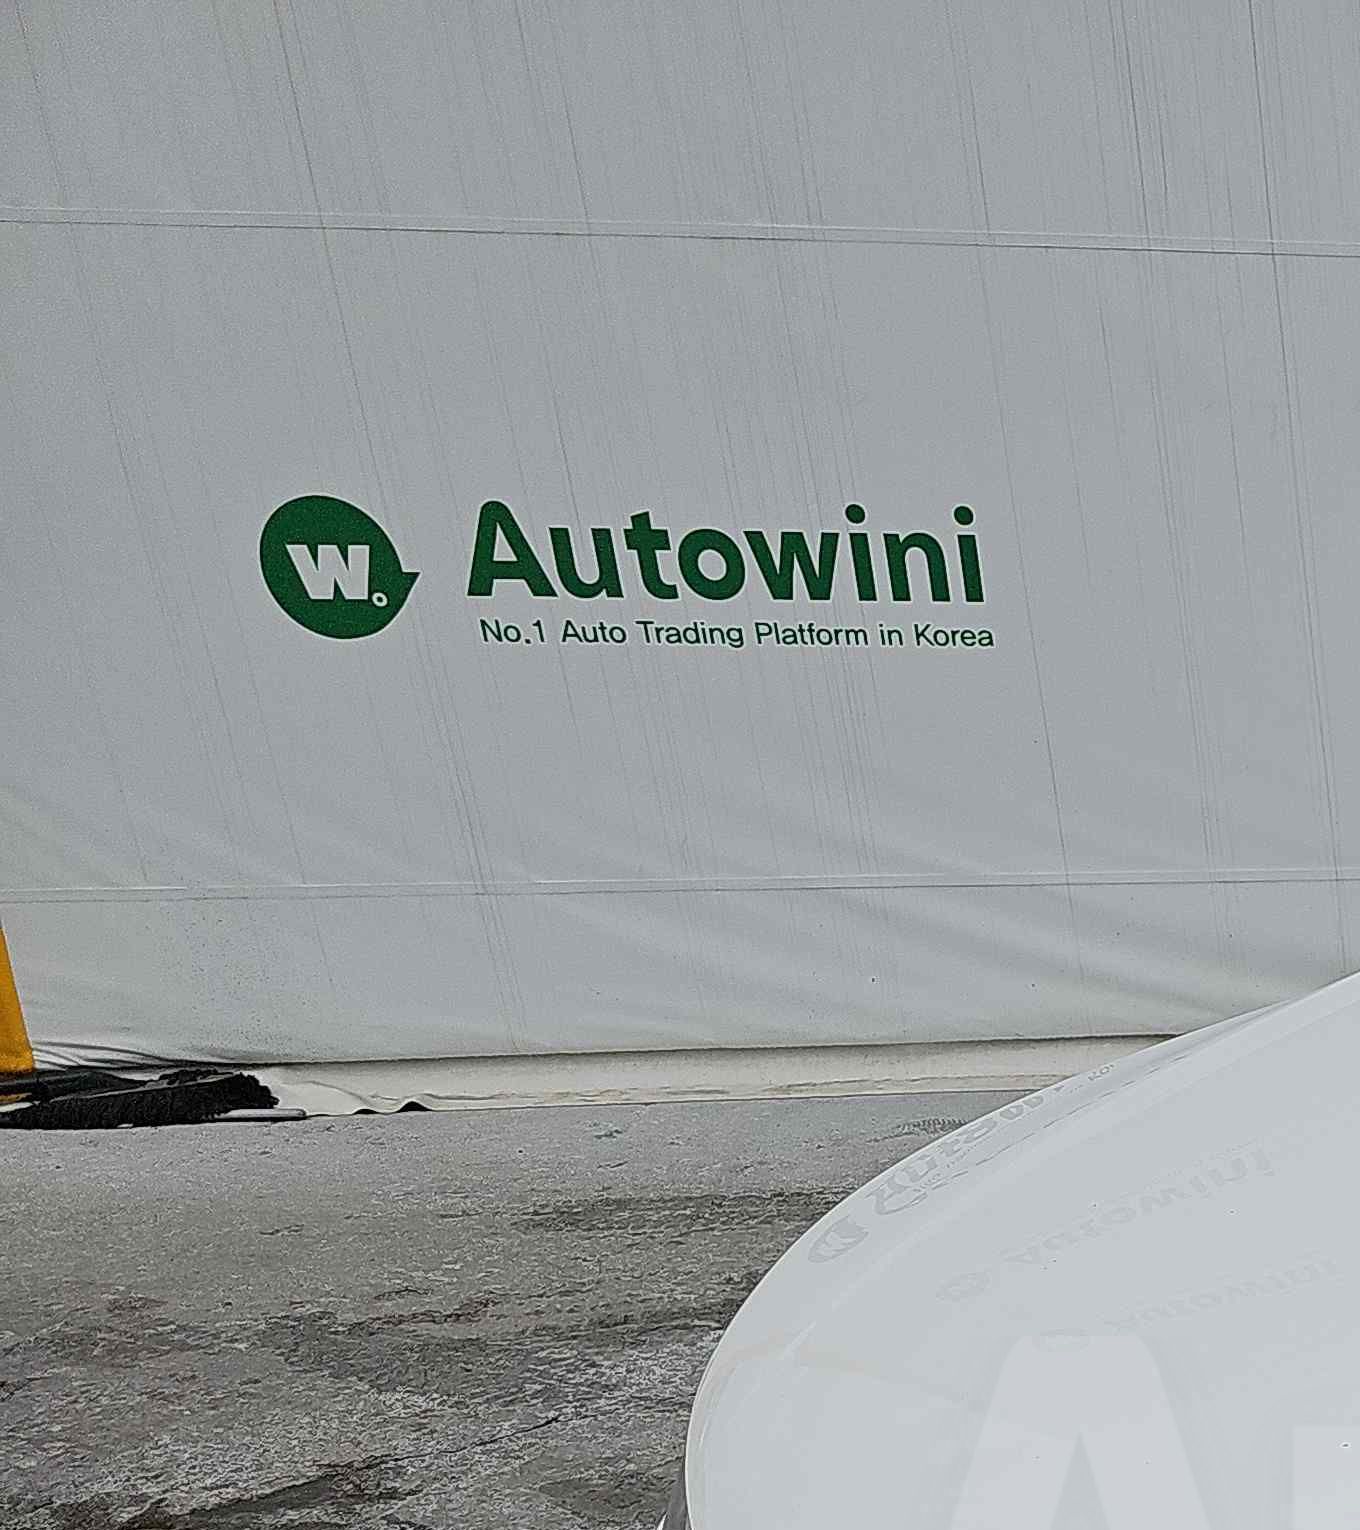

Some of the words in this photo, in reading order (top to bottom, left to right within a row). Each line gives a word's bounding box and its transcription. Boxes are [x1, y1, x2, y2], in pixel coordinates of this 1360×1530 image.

[466, 500, 985, 604] Autowini
[479, 618, 546, 645] No.1
[562, 619, 627, 645] Auto
[635, 620, 745, 650] Trading
[754, 621, 869, 647] Platform
[879, 623, 905, 647] in
[913, 623, 994, 648] Korea
